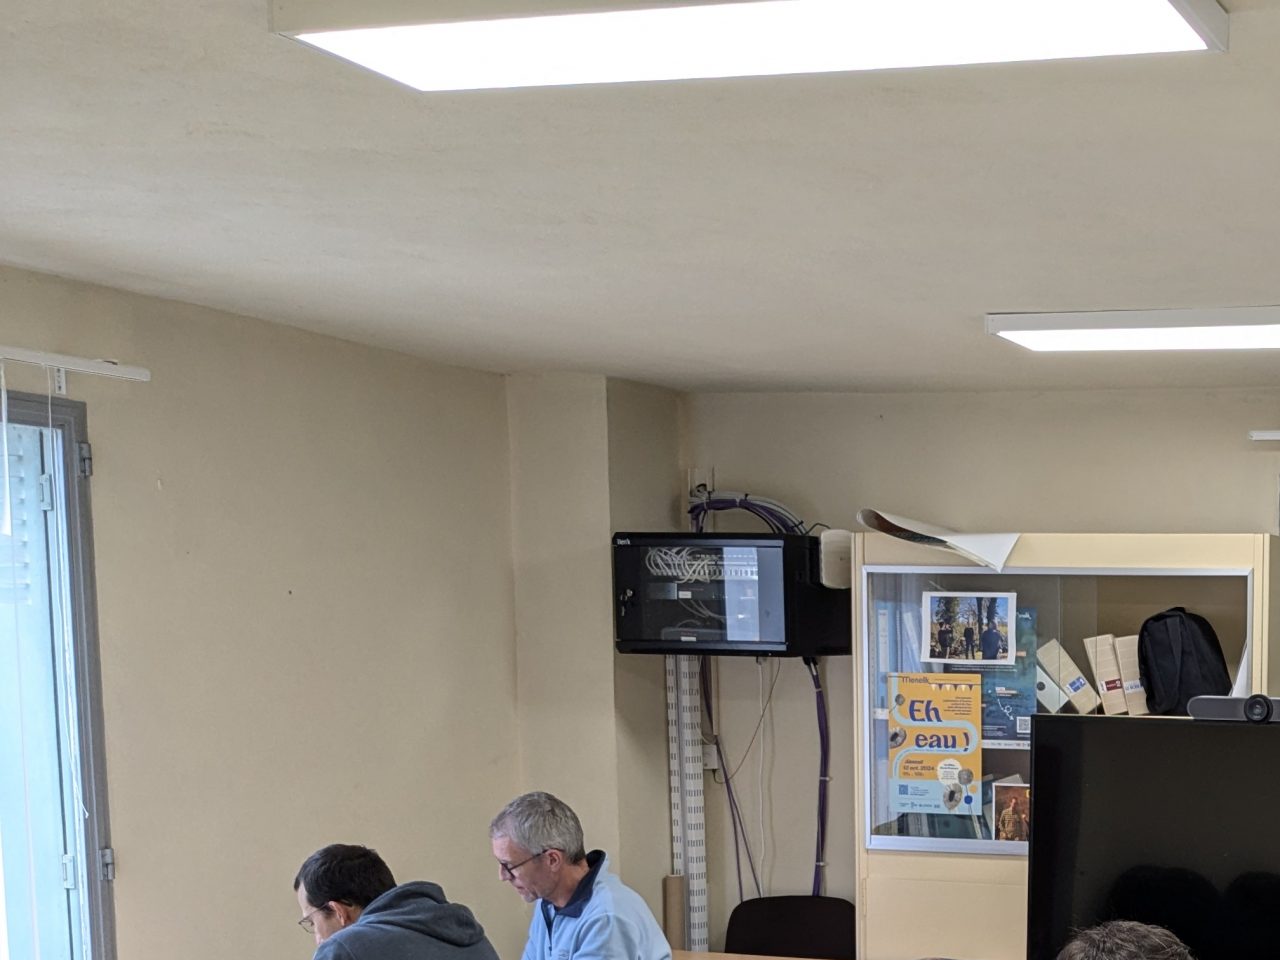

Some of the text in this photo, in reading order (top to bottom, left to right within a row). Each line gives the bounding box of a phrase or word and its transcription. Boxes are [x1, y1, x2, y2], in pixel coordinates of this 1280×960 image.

[909, 700, 943, 722] Eh
[915, 732, 970, 752] eau !
